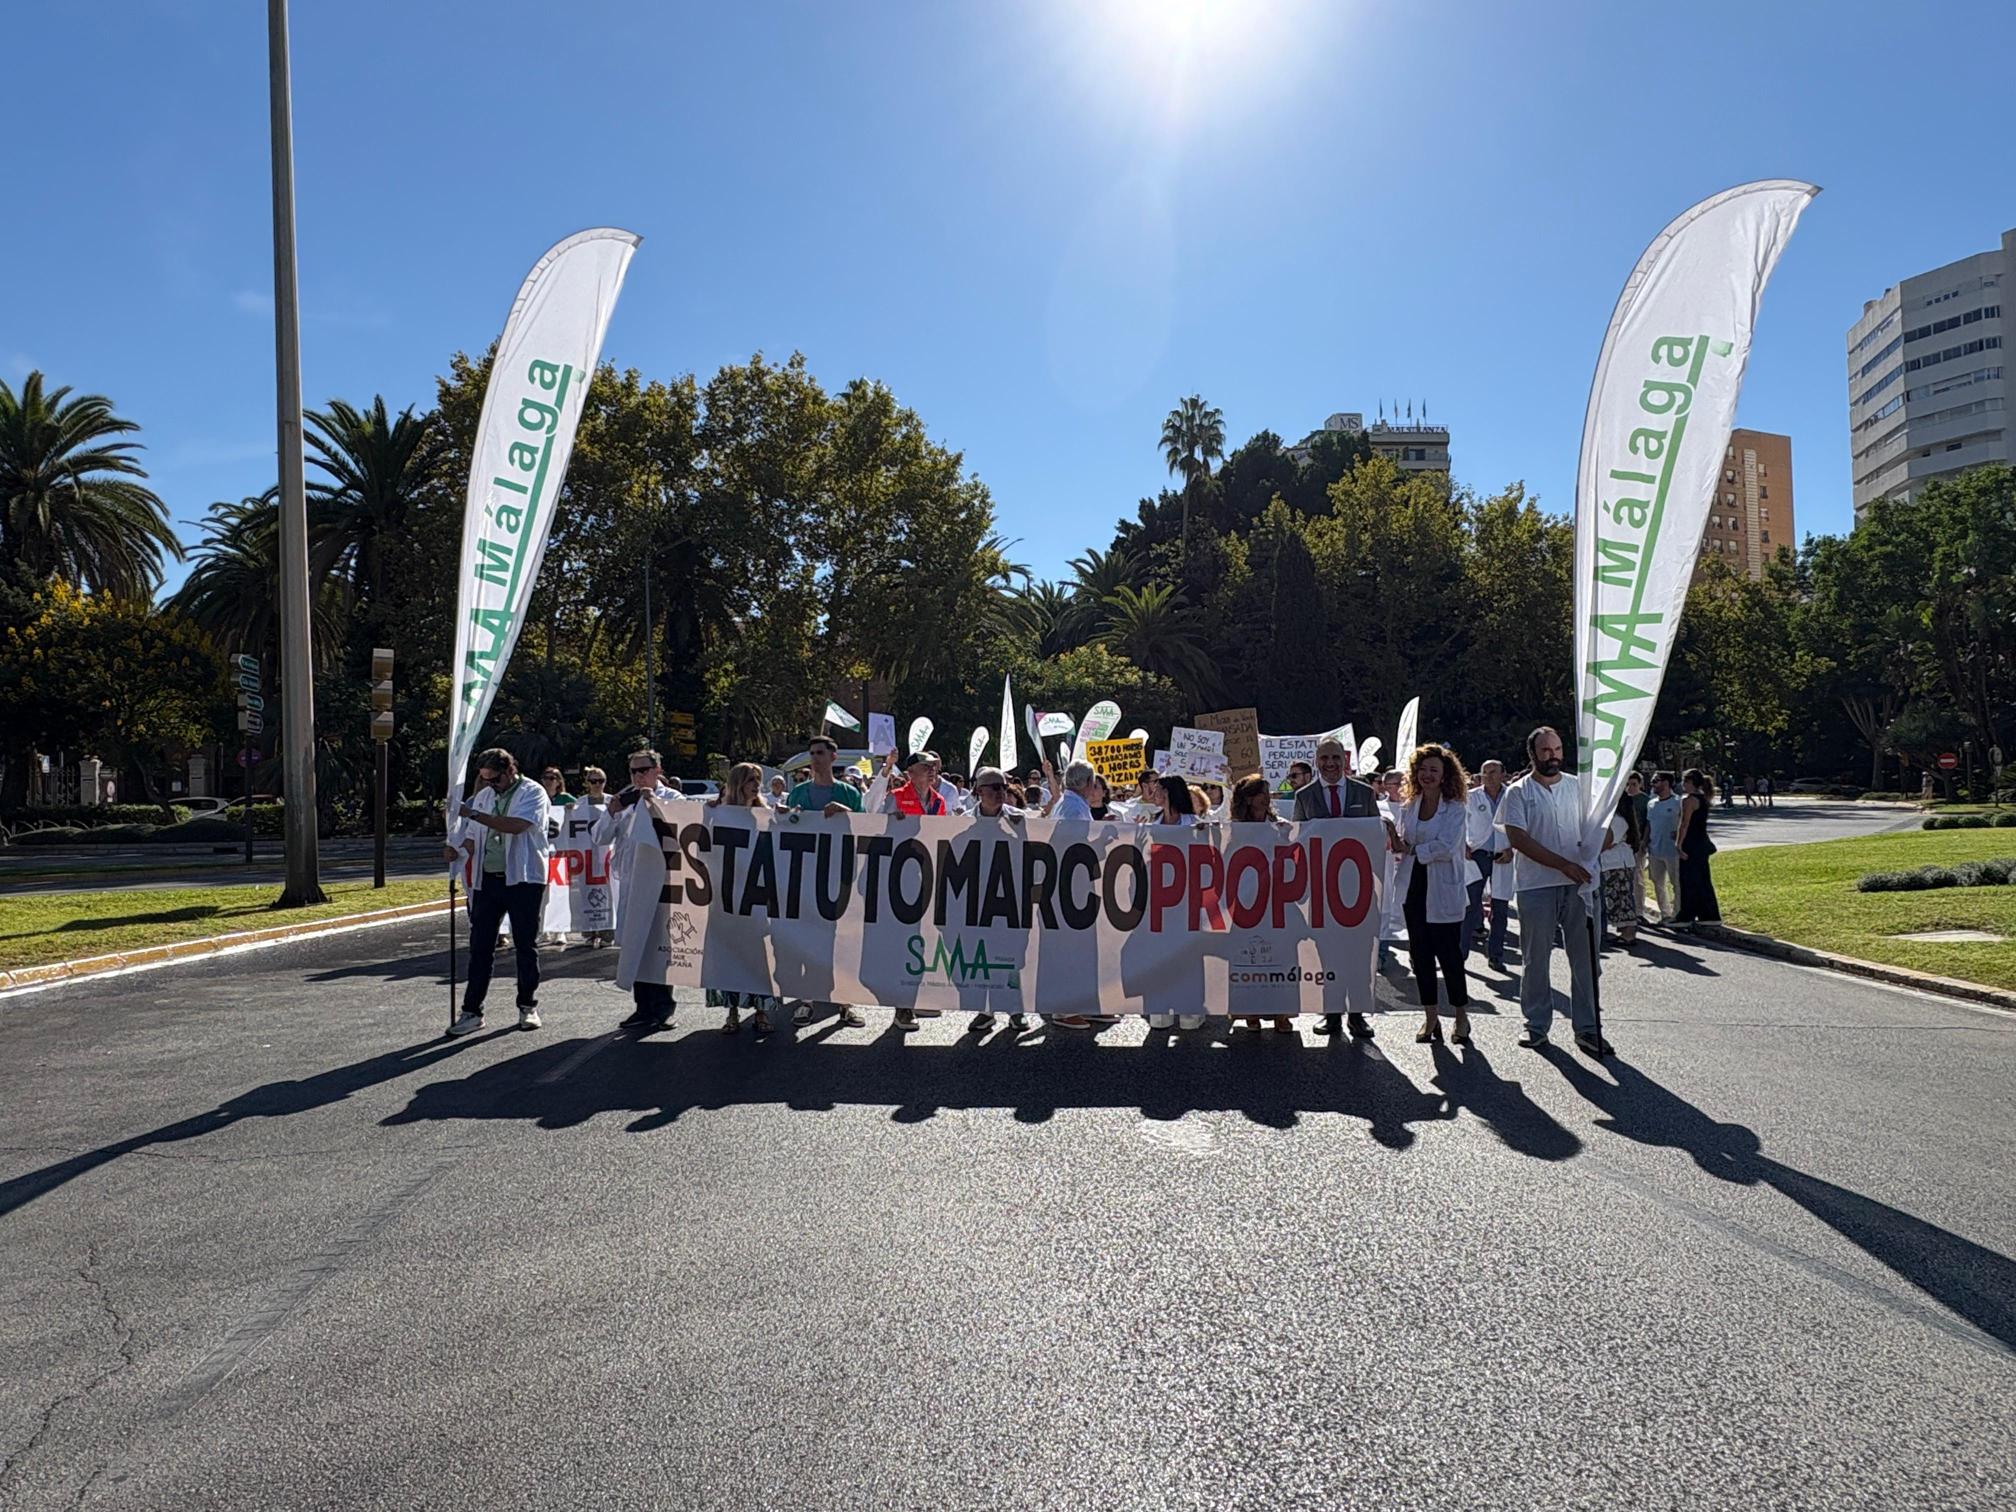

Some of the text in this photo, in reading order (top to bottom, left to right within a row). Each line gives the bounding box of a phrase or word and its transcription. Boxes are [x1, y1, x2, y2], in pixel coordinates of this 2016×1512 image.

[1339, 417, 1359, 429] MS
[1592, 334, 1696, 589] Málaga
[473, 357, 560, 588] Málaga
[1183, 733, 1209, 745] NO SOY
[1108, 759, 1141, 773] HORAS
[905, 933, 991, 985] SMA
[1229, 966, 1336, 986] commálaga
